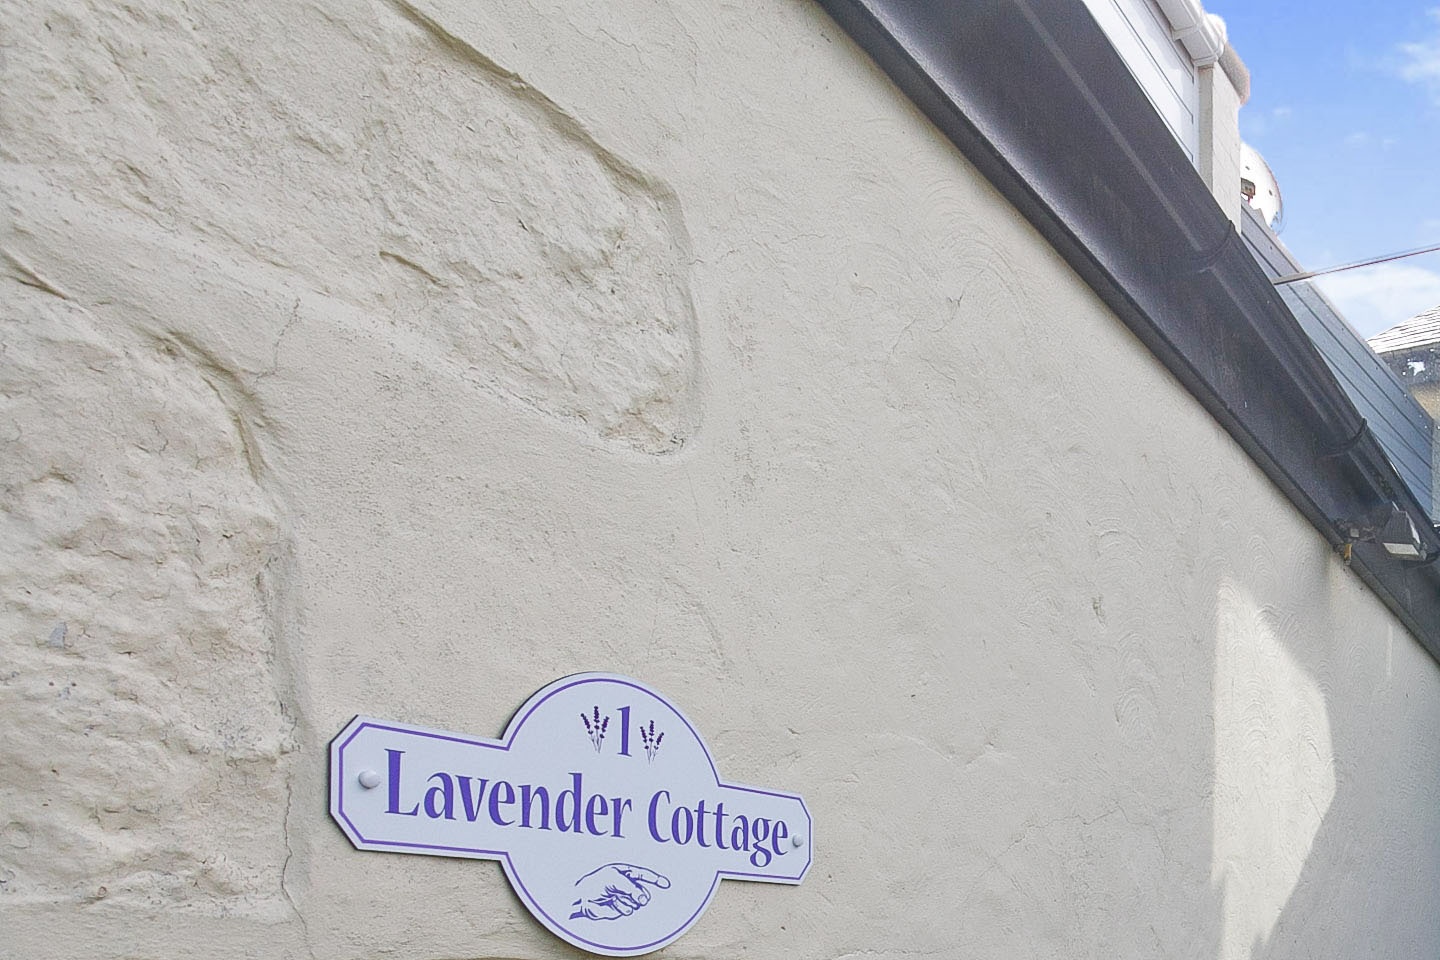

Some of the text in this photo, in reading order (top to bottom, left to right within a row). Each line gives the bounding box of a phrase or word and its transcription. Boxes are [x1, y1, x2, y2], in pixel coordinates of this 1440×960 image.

[616, 705, 632, 758] 1
[384, 748, 789, 868] Lavender Cottage
